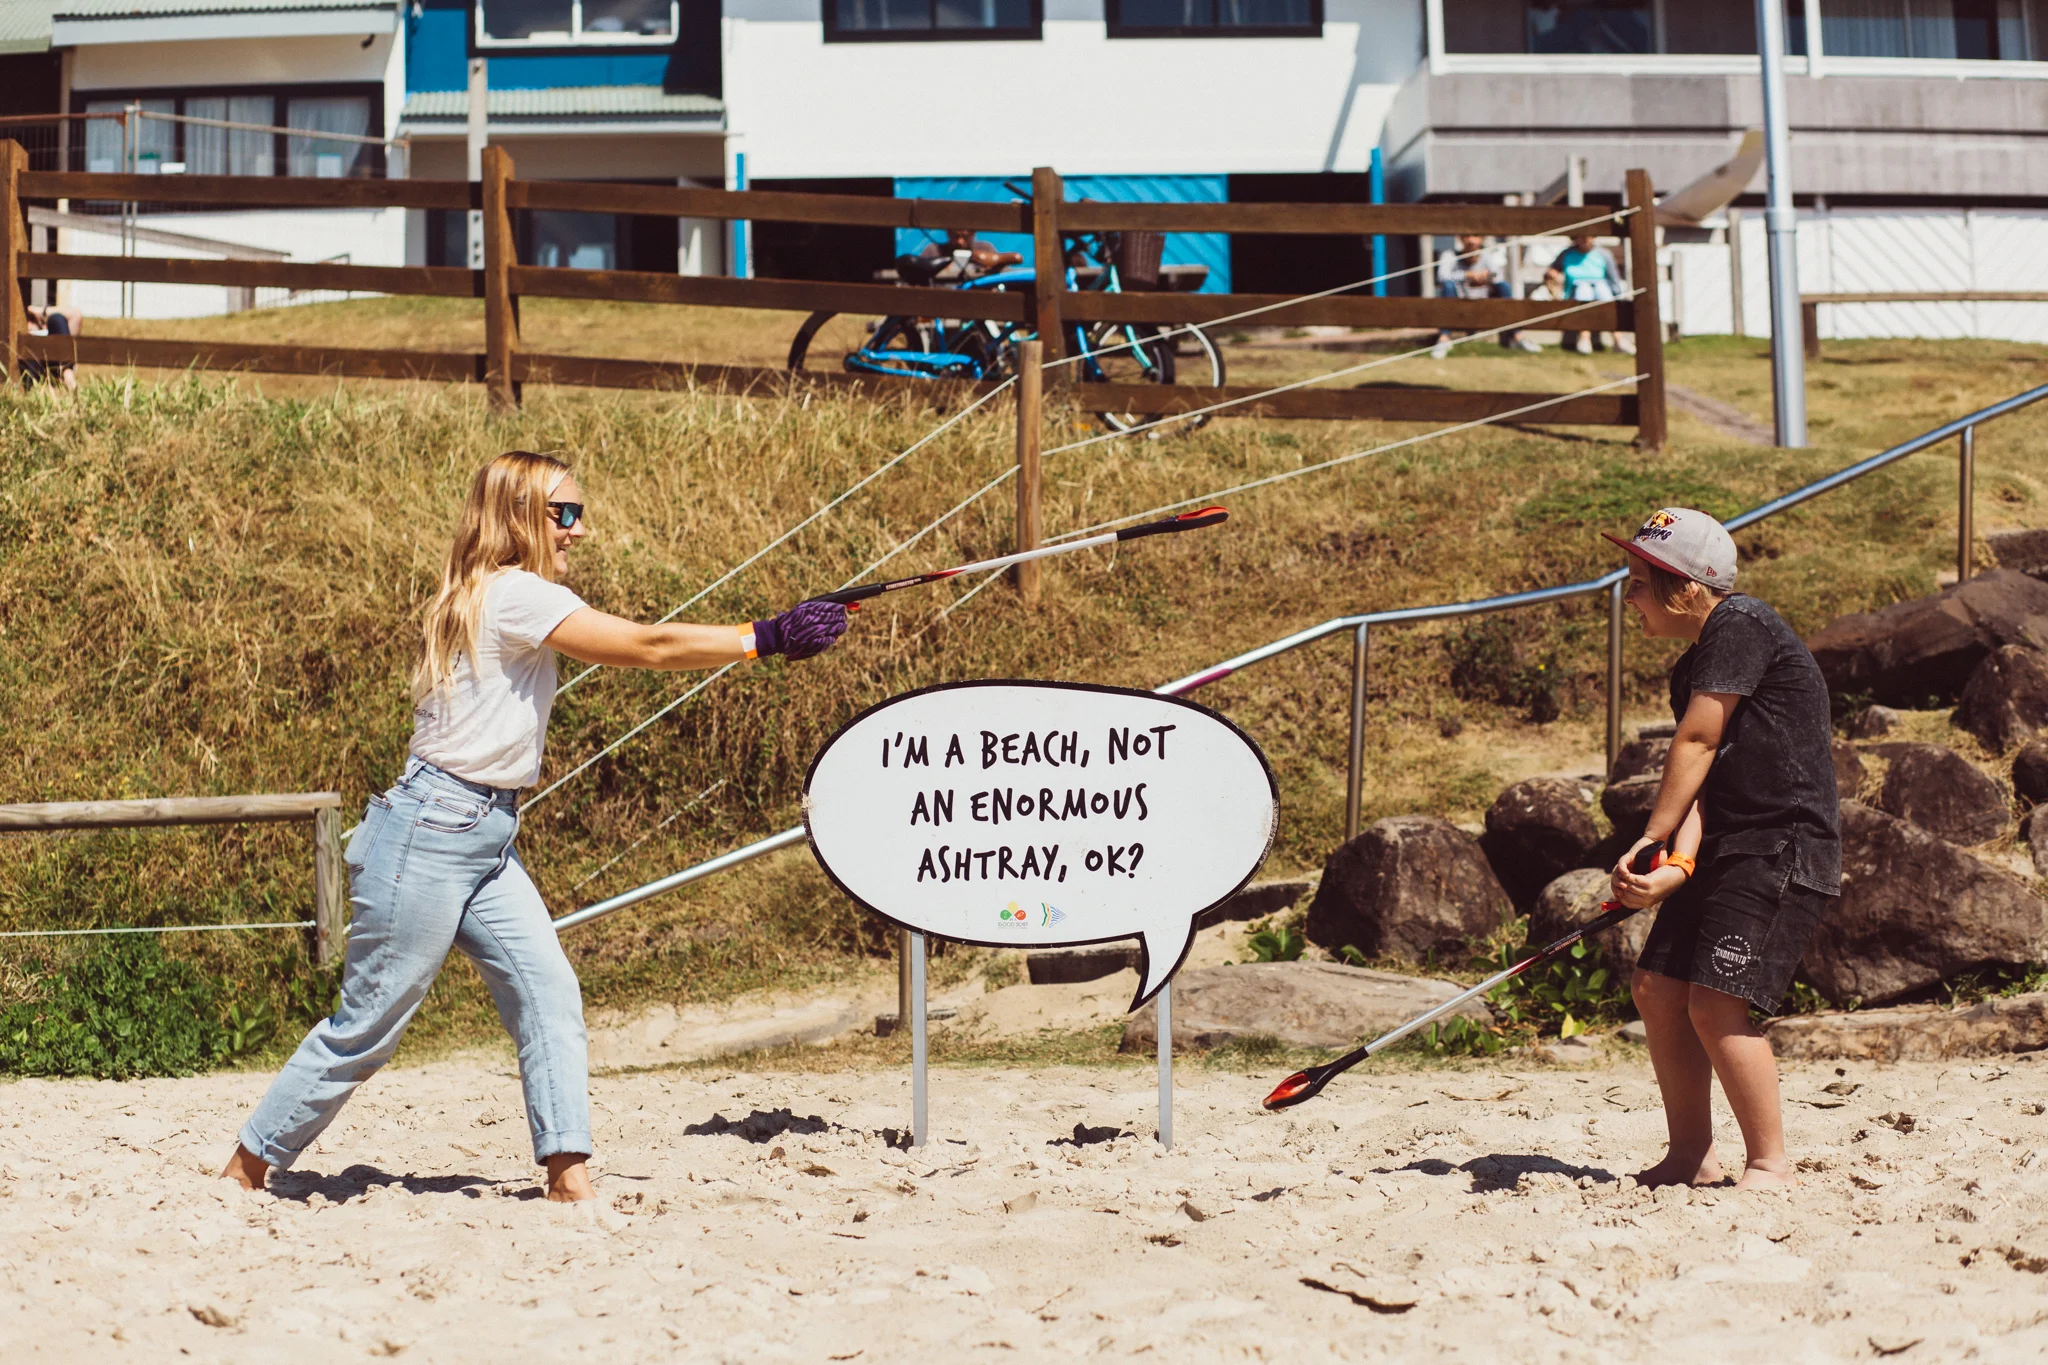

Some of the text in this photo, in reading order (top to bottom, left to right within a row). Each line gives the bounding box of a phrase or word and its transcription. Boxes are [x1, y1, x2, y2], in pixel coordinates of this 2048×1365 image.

[882, 724, 1177, 770] I'M A BEACH, NOT
[910, 782, 1148, 827] AN ENORMOUS
[917, 842, 1144, 883] ASHTRAY, OK?
